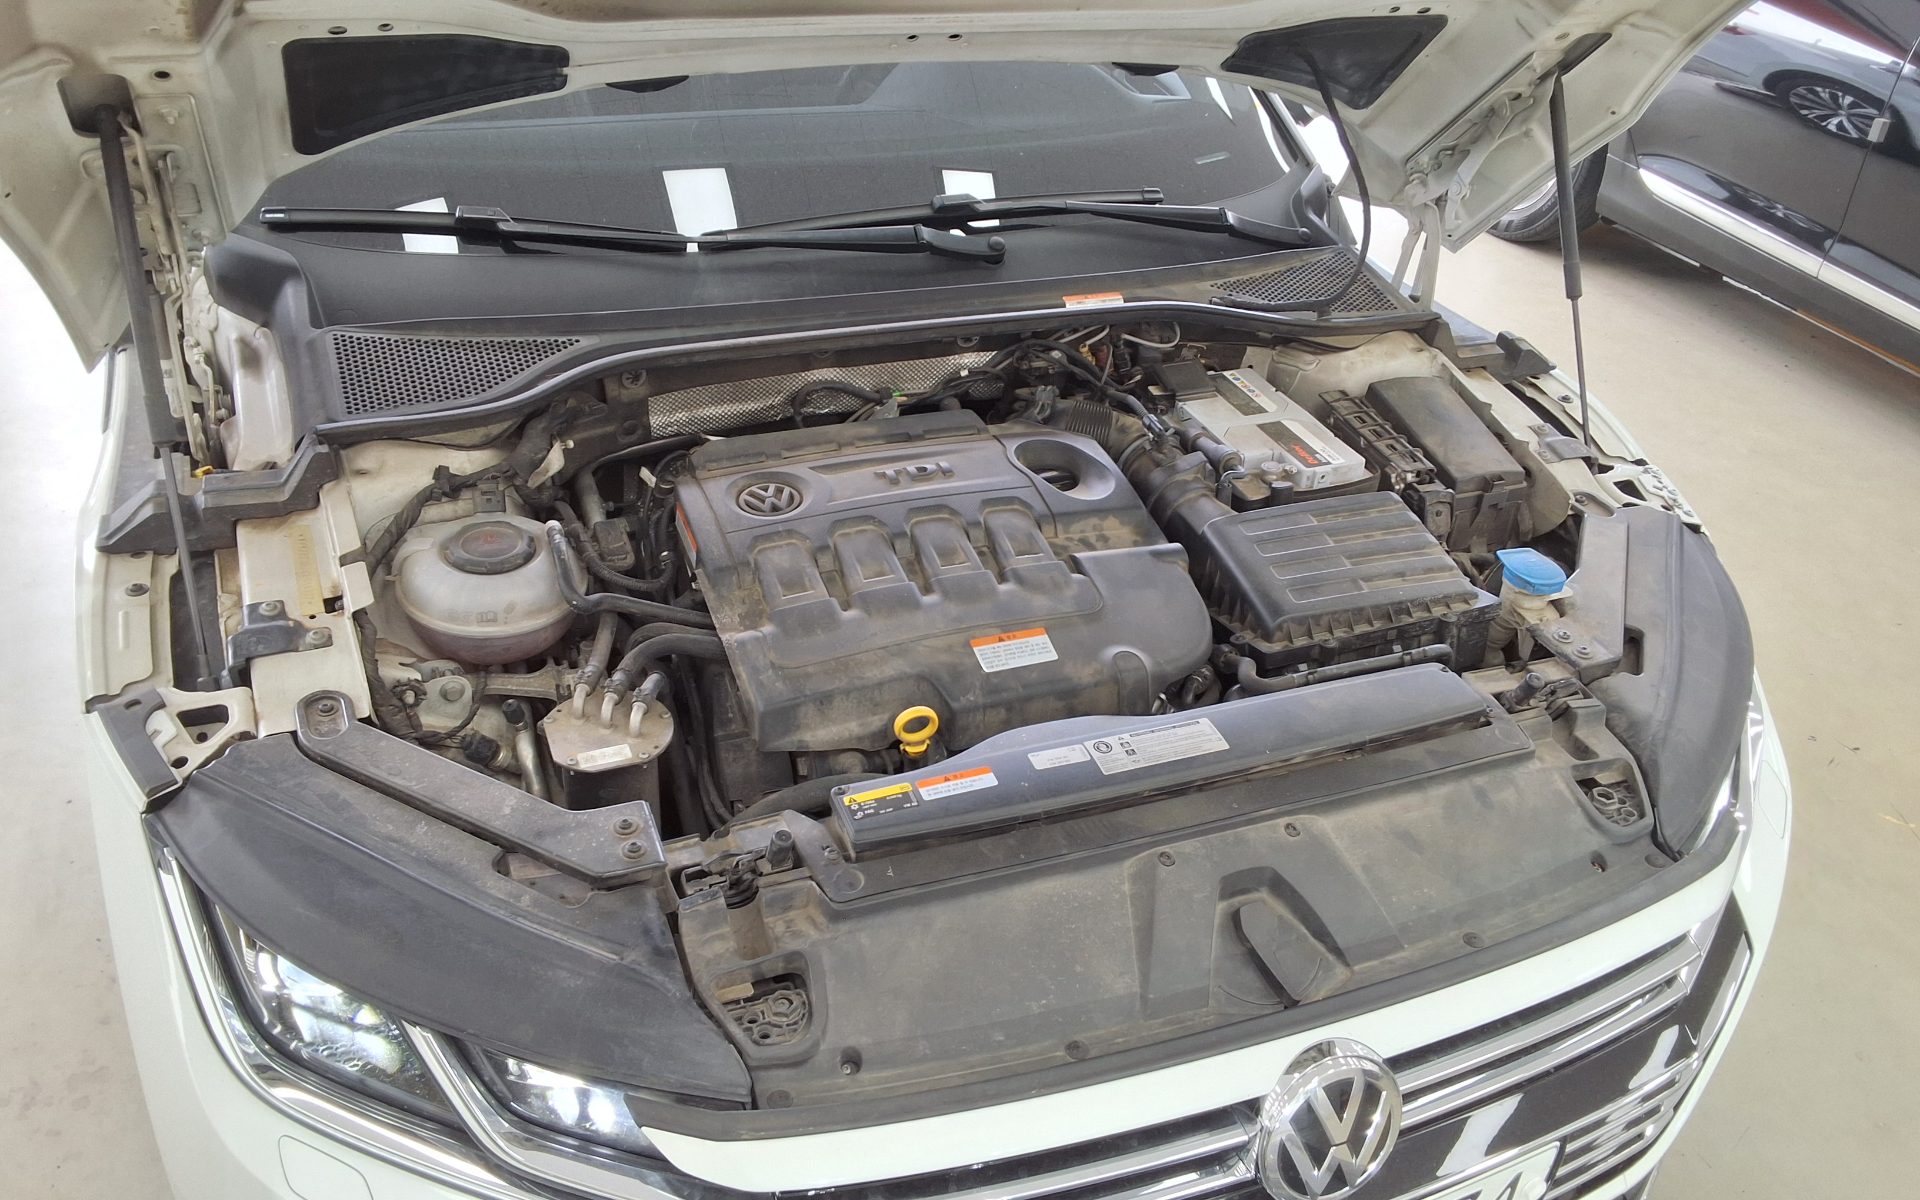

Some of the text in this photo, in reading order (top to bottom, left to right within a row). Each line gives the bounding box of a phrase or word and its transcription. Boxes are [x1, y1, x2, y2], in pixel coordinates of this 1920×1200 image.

[873, 460, 955, 485] TDI
[740, 483, 802, 516] VW
[1268, 1062, 1396, 1200] VW
